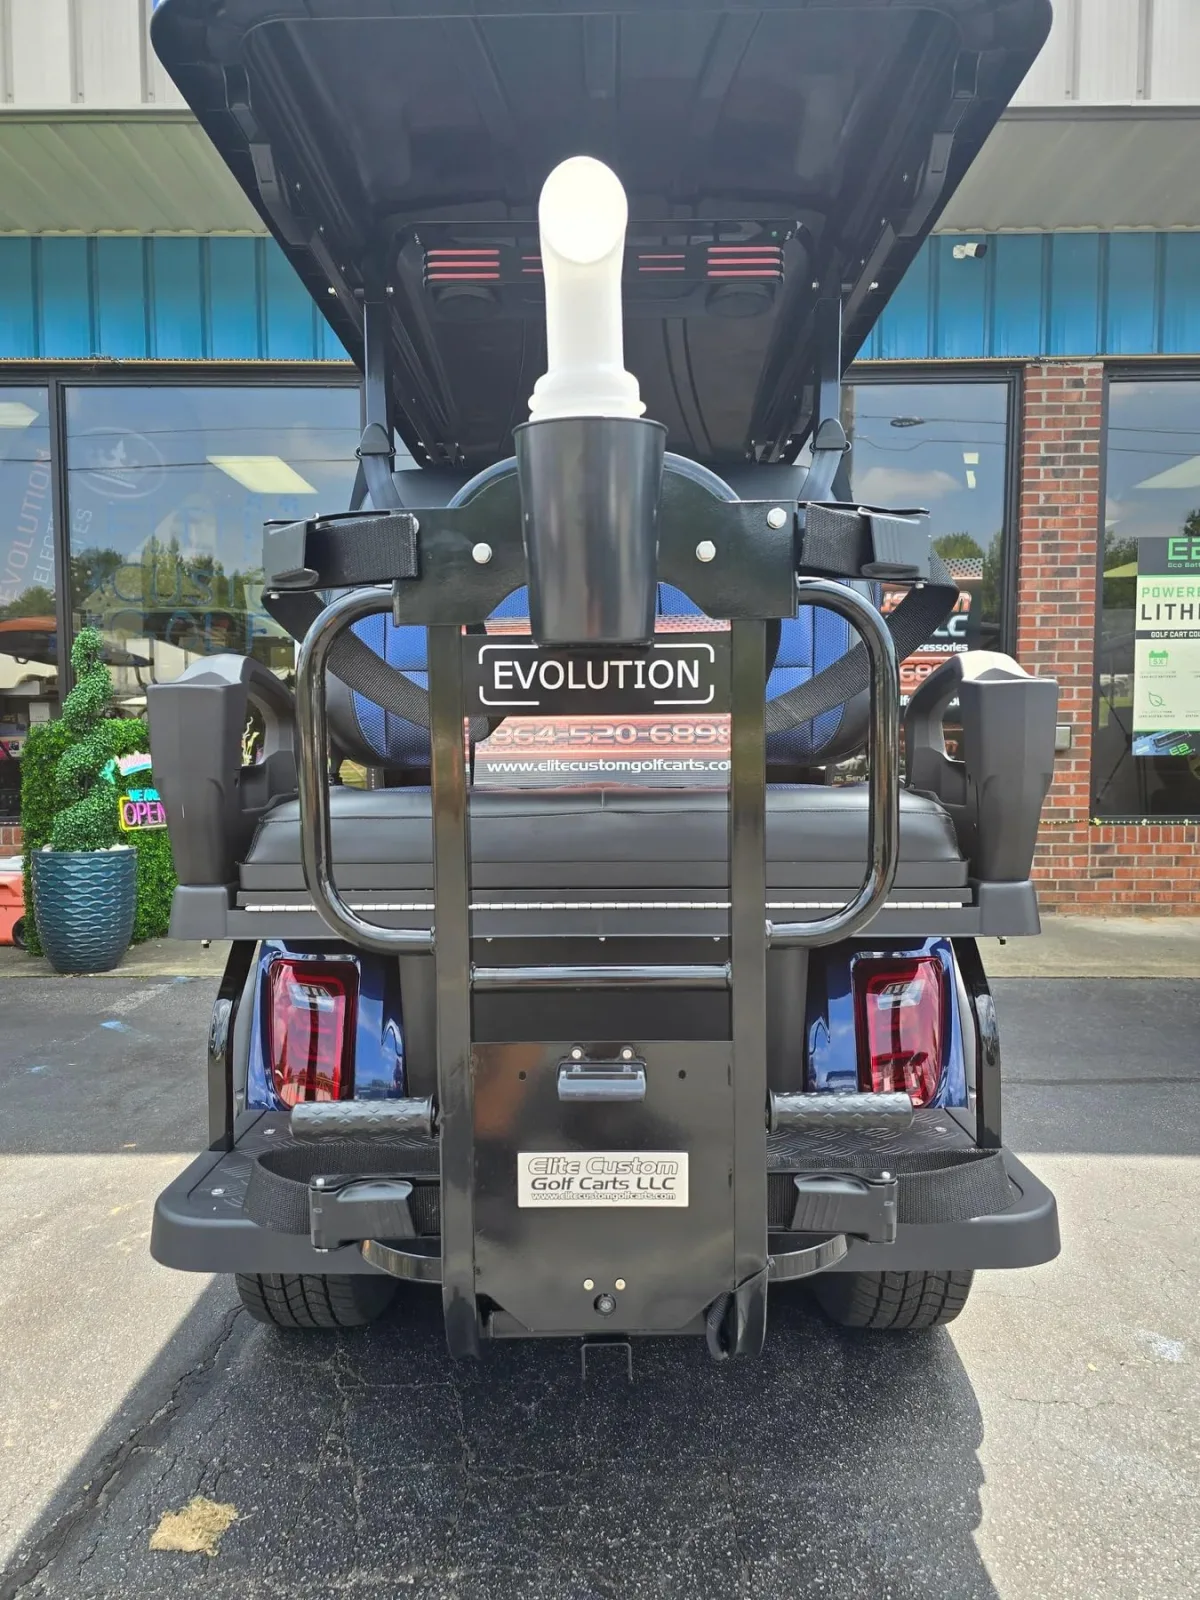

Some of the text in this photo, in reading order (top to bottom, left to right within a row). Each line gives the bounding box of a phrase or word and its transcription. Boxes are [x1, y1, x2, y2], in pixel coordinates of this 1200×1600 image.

[917, 642, 969, 652] cessories
[494, 660, 699, 689] EVOLUTION
[487, 758, 730, 774] www.elitecustomgolfcarts.co
[124, 802, 166, 825] OPEN
[528, 1157, 678, 1175] Elite Custom
[531, 1177, 676, 1191] Golf Carts LLC
[531, 1191, 676, 1202] www.elitecustomgolfcarts.com
